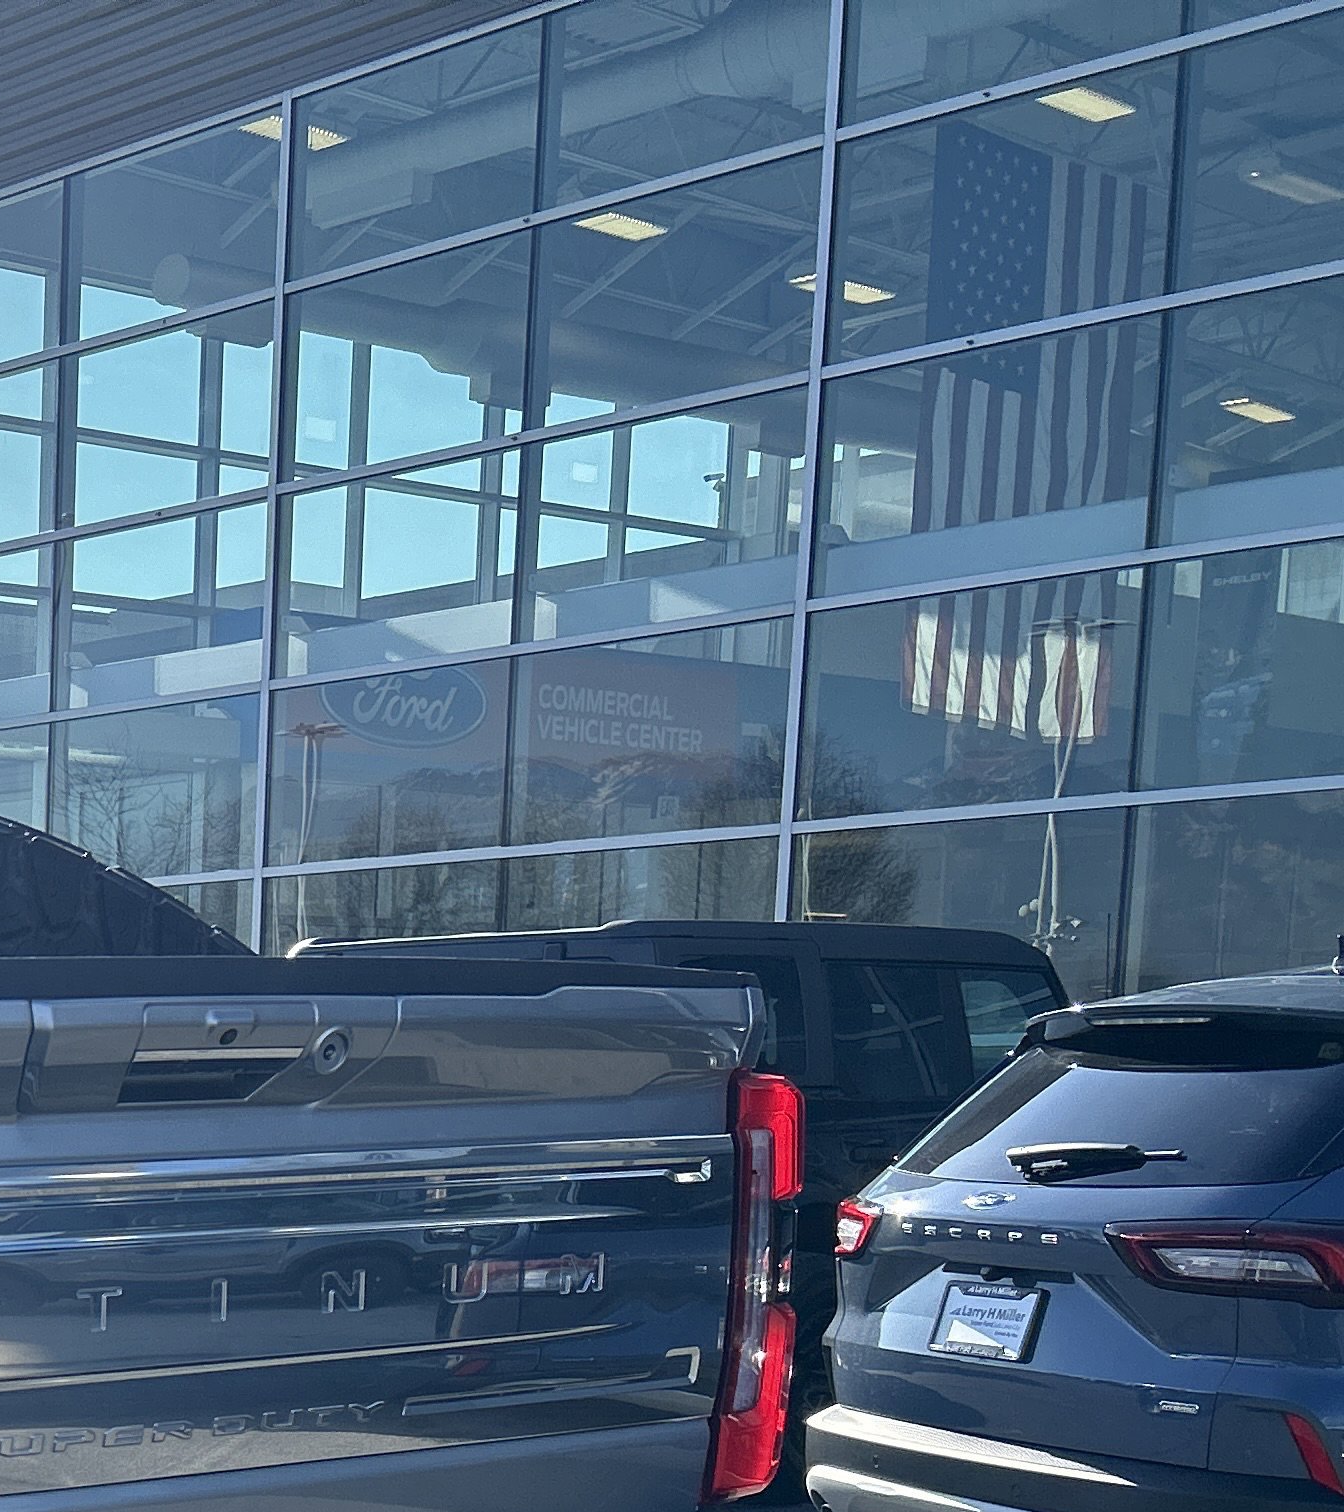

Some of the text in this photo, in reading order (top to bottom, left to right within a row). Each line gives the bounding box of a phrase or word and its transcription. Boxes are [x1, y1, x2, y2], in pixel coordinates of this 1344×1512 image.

[353, 671, 459, 732] Ford
[538, 683, 674, 722] COMMERCIAL
[537, 714, 704, 752] VEHICLE CENTER
[960, 1304, 1026, 1322] Larry H Miller
[213, 1400, 385, 1437] DUTY
